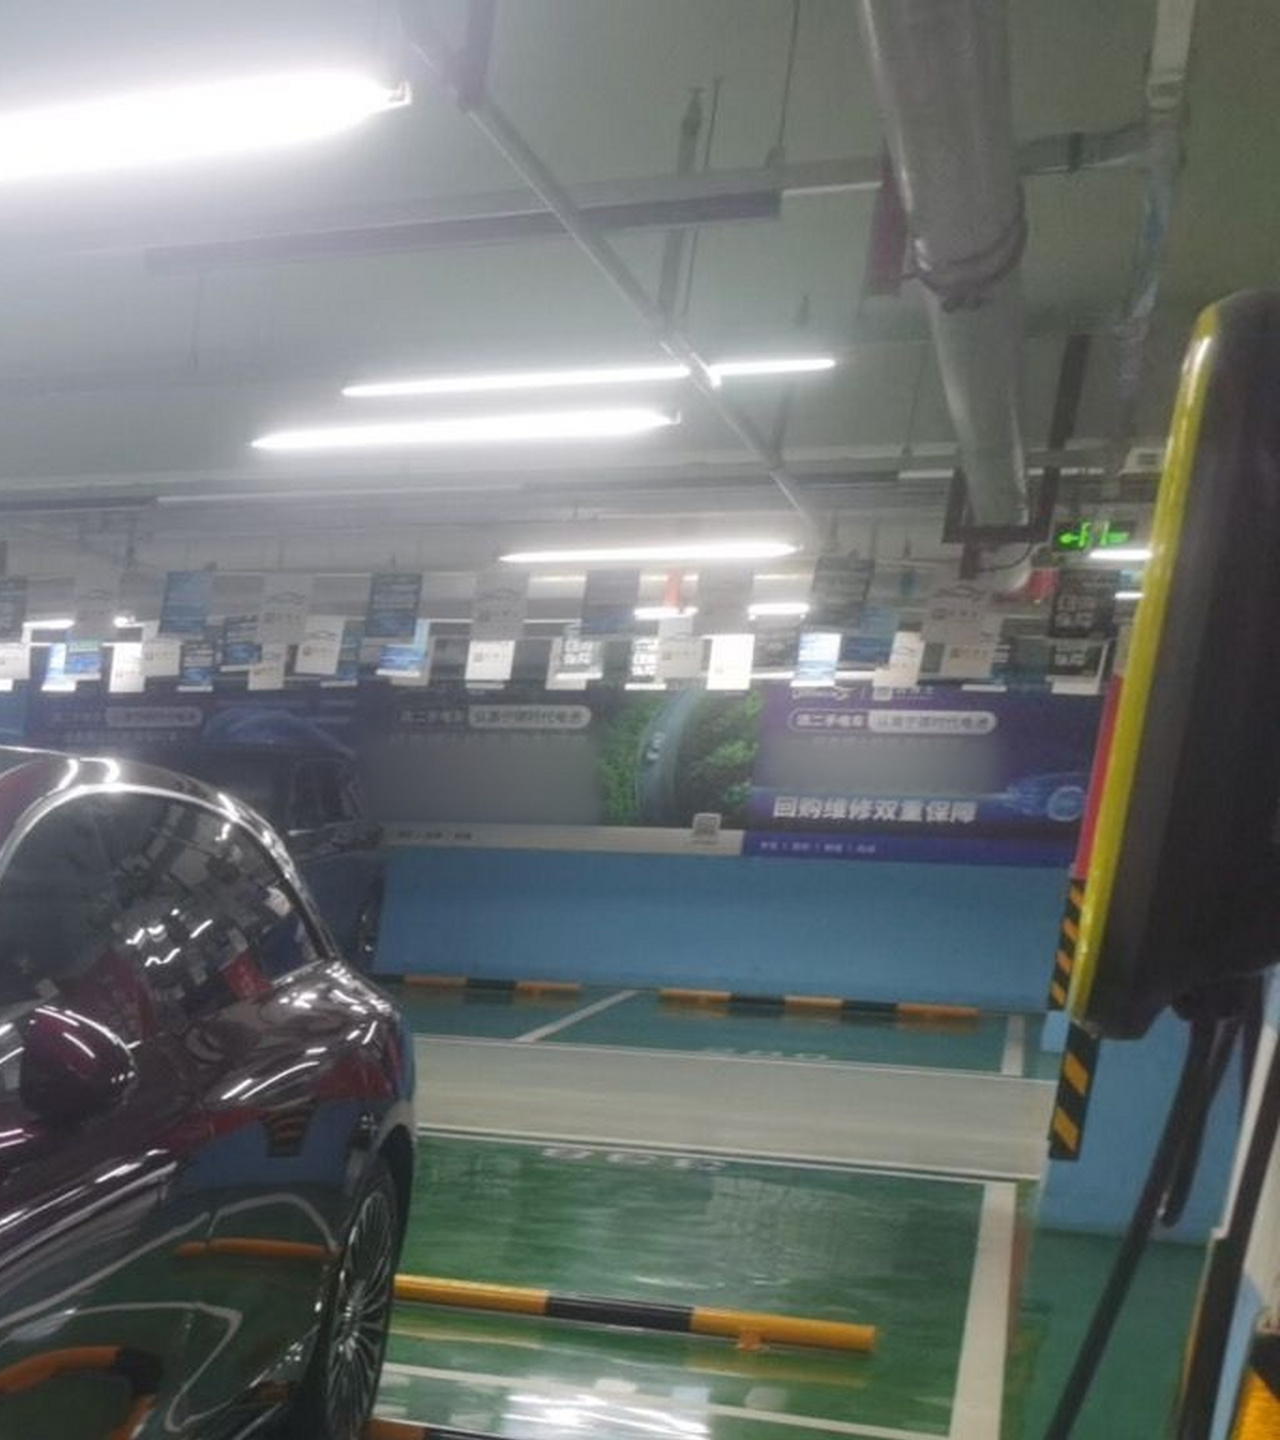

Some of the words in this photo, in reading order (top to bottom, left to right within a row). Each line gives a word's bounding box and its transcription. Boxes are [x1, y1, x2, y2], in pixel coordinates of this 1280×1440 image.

[773, 797, 980, 823] 回购维修双重保障
